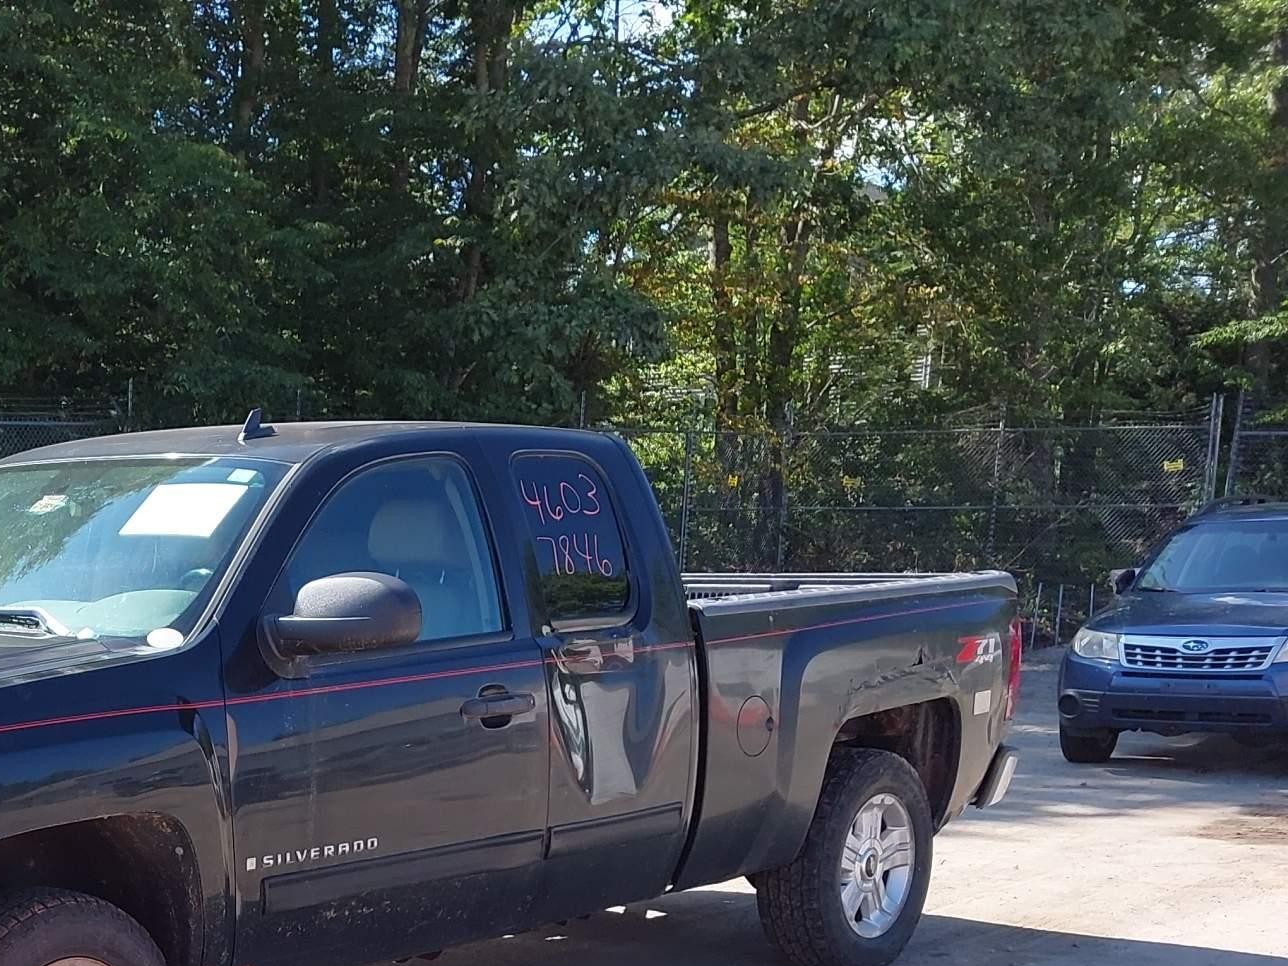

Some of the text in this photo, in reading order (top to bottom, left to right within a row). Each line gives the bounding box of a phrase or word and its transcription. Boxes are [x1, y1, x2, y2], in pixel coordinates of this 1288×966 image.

[519, 473, 601, 525] 4603
[536, 532, 613, 577] 7846
[956, 635, 996, 663] Z71
[262, 837, 379, 868] SILVERADO
